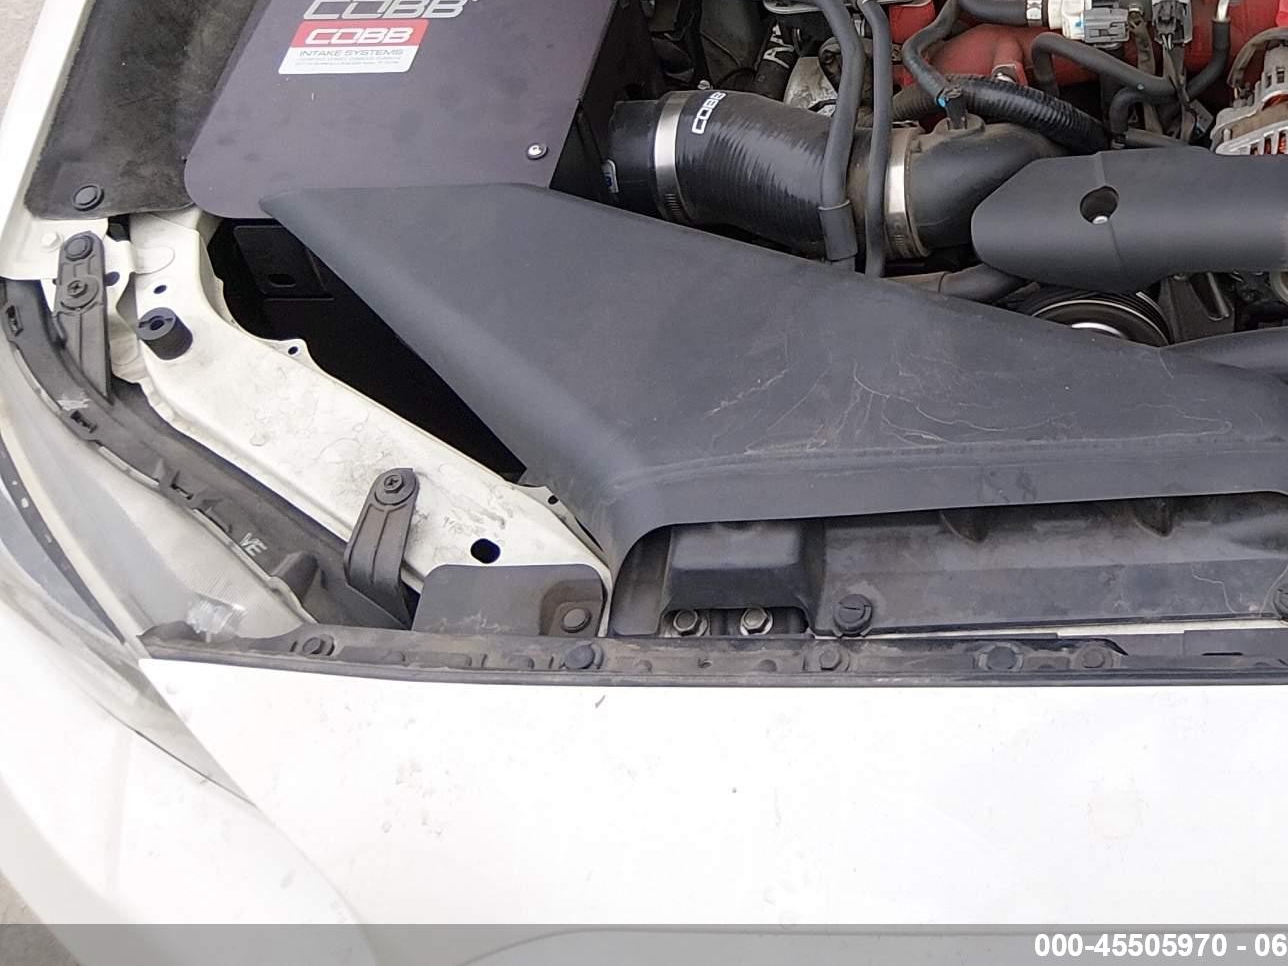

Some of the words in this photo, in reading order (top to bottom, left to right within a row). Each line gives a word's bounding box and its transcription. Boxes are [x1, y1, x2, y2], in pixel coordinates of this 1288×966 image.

[305, 27, 413, 45] COBB
[299, 49, 341, 57] INTAKE
[343, 48, 404, 57] SYSTEMS
[692, 92, 727, 134] COBB
